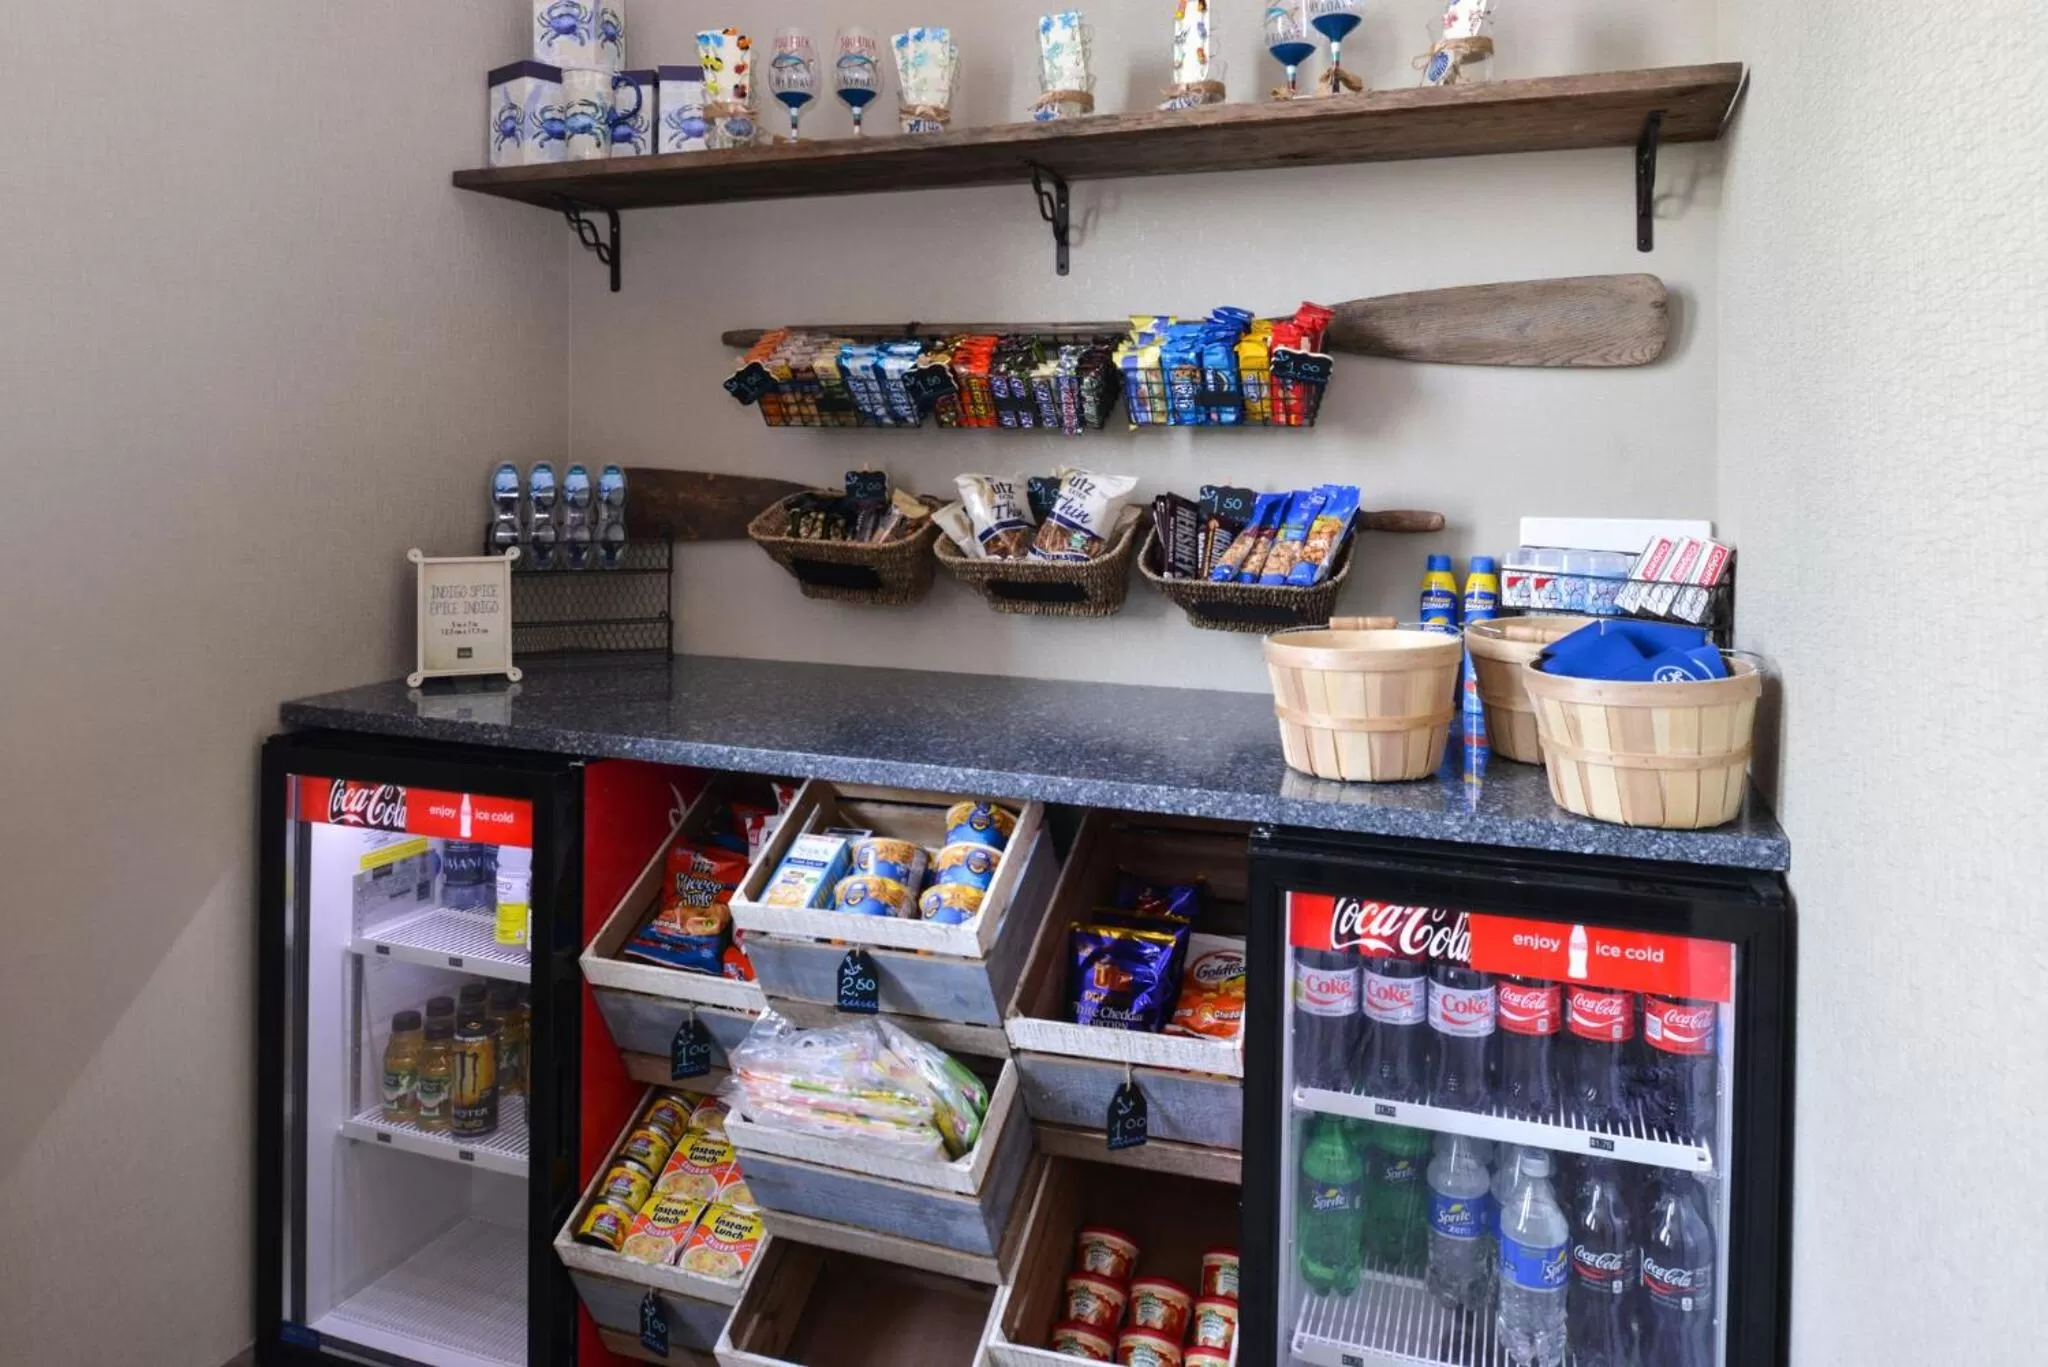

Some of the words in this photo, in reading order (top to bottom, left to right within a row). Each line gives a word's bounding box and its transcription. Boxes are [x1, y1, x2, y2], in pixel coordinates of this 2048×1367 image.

[328, 778, 407, 829] Coca-Cola
[429, 805, 456, 819] enjoy
[475, 808, 489, 820] ice
[491, 810, 514, 824] cold
[1331, 897, 1472, 963] Coca-Cola
[1512, 933, 1560, 952] enjoy
[1595, 940, 1621, 957] ice
[1624, 946, 1664, 963] cold
[1305, 974, 1351, 995] Coke
[1367, 979, 1410, 1002] Coke
[1442, 994, 1488, 1016] Coke
[1501, 987, 1549, 1009] Coca-Cola
[1573, 993, 1624, 1016] Coca-Cola
[689, 1152, 718, 1163] Lunch
[690, 1144, 727, 1157] Instant
[653, 1203, 689, 1217] Instant
[1313, 1194, 1346, 1210] Sprite
[652, 1212, 680, 1225] Lunch
[715, 1216, 753, 1233] Instant
[1437, 1209, 1472, 1225] Sprite
[714, 1225, 743, 1240] Lunch
[1574, 1244, 1623, 1271] Coca-Cola
[1644, 1257, 1693, 1287] Coca-Cola
